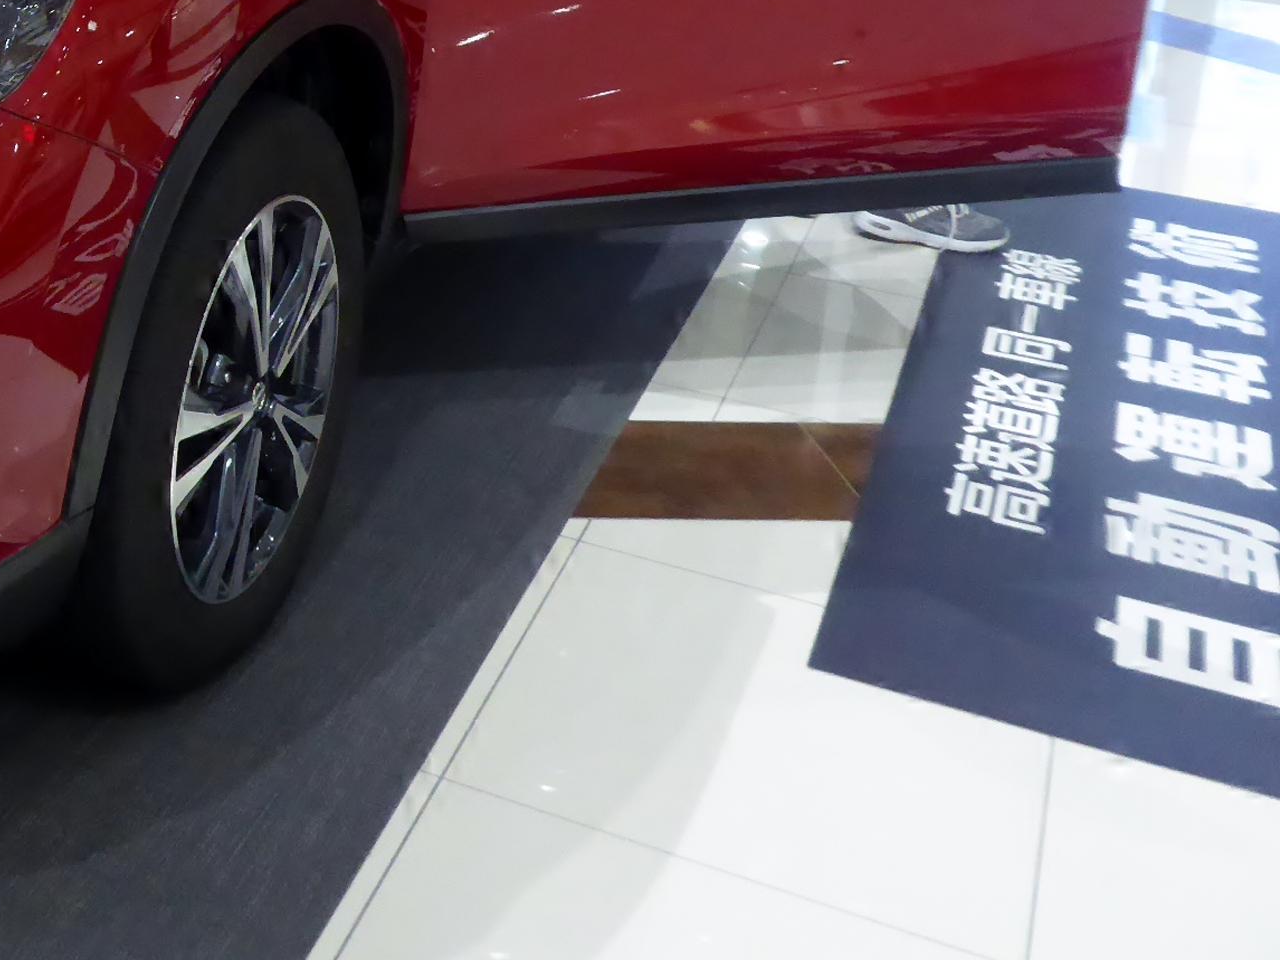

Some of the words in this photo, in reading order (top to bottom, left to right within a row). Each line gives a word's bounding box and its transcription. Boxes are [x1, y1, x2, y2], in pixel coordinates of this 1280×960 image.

[943, 248, 1084, 536] 高速道路同一車線
[1093, 216, 1280, 709] 自動運転技術
